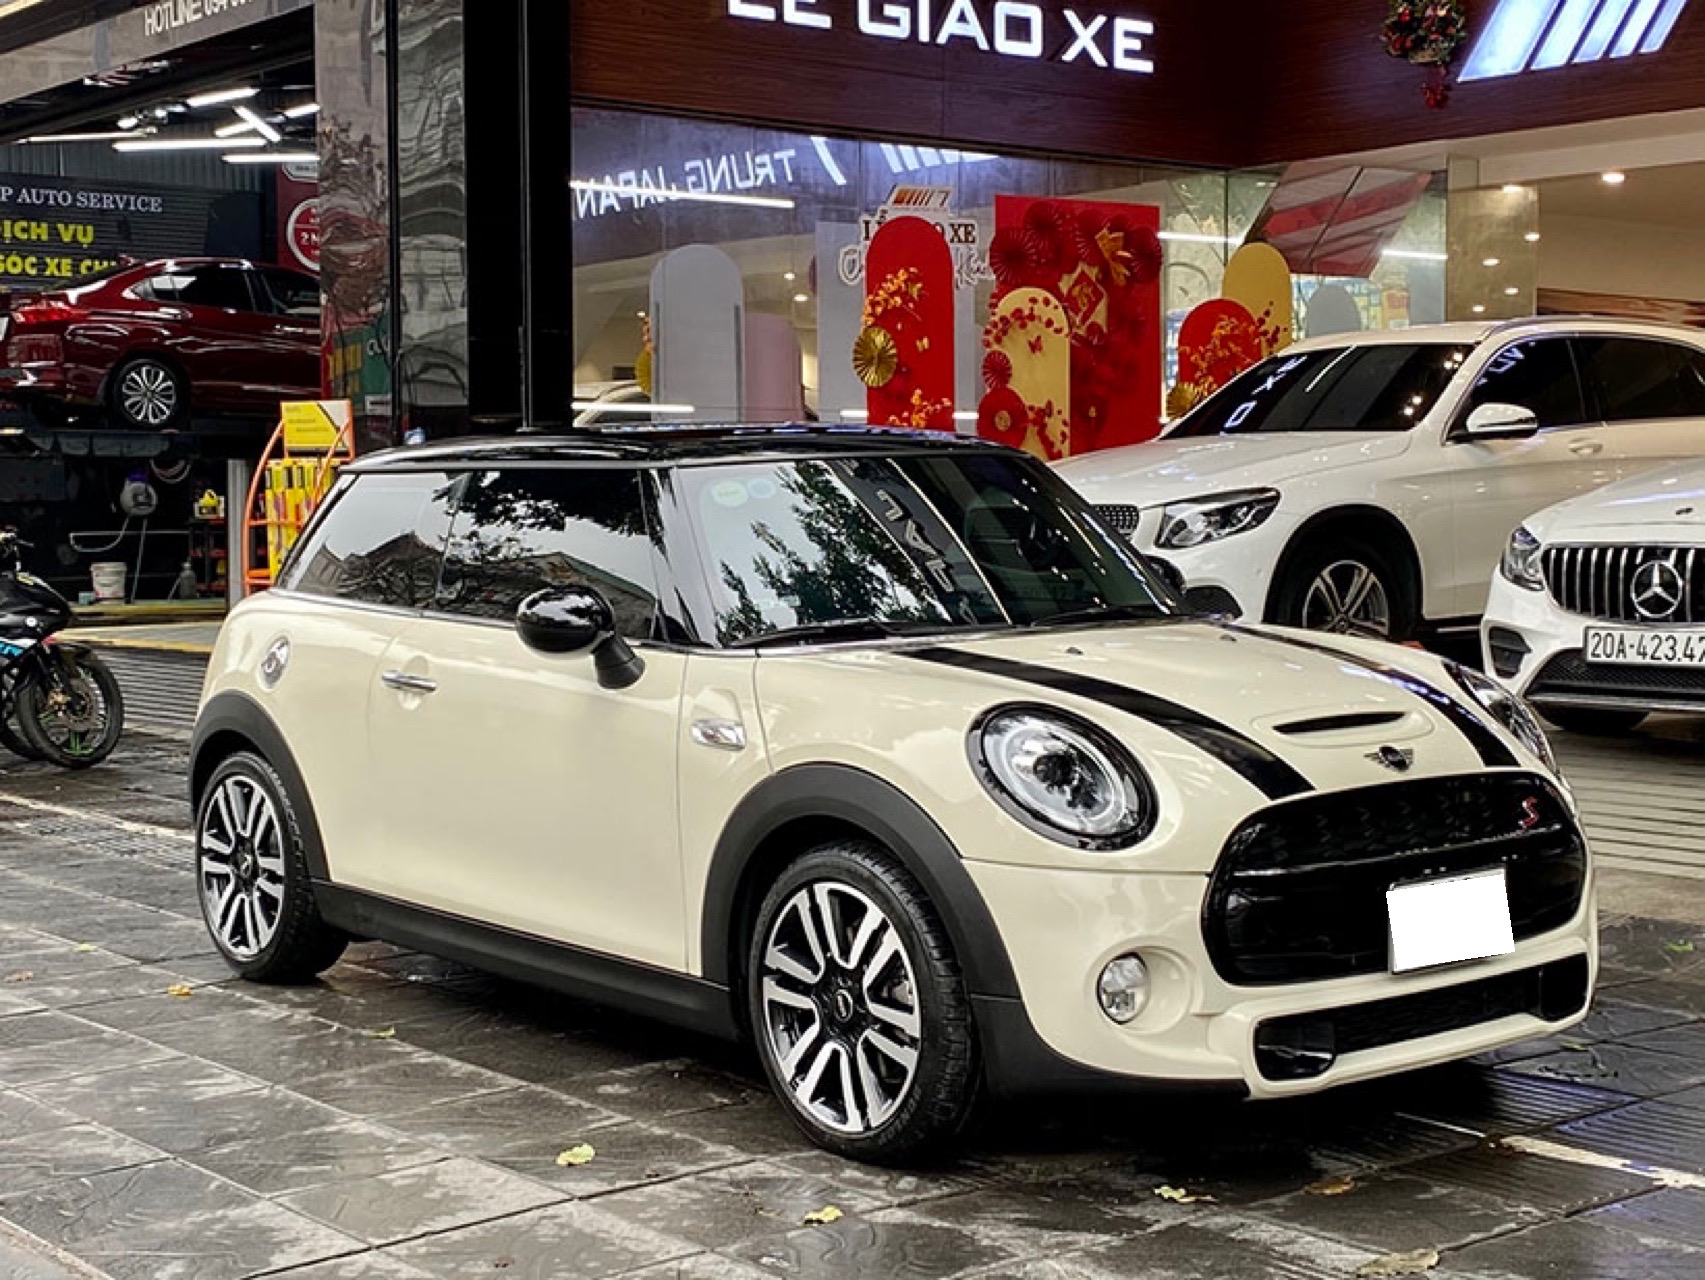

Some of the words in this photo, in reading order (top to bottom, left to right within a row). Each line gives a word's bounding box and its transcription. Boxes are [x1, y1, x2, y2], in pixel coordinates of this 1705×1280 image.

[144, 0, 202, 36] HOTLINE
[858, 0, 1043, 58] GIAO
[1061, 9, 1155, 74] XE
[16, 188, 72, 206] AUTO
[76, 191, 163, 213] SERVICE
[0, 219, 49, 243] ỊCH
[57, 223, 95, 248] VỤ
[949, 223, 976, 244] XE
[44, 256, 73, 277] XE
